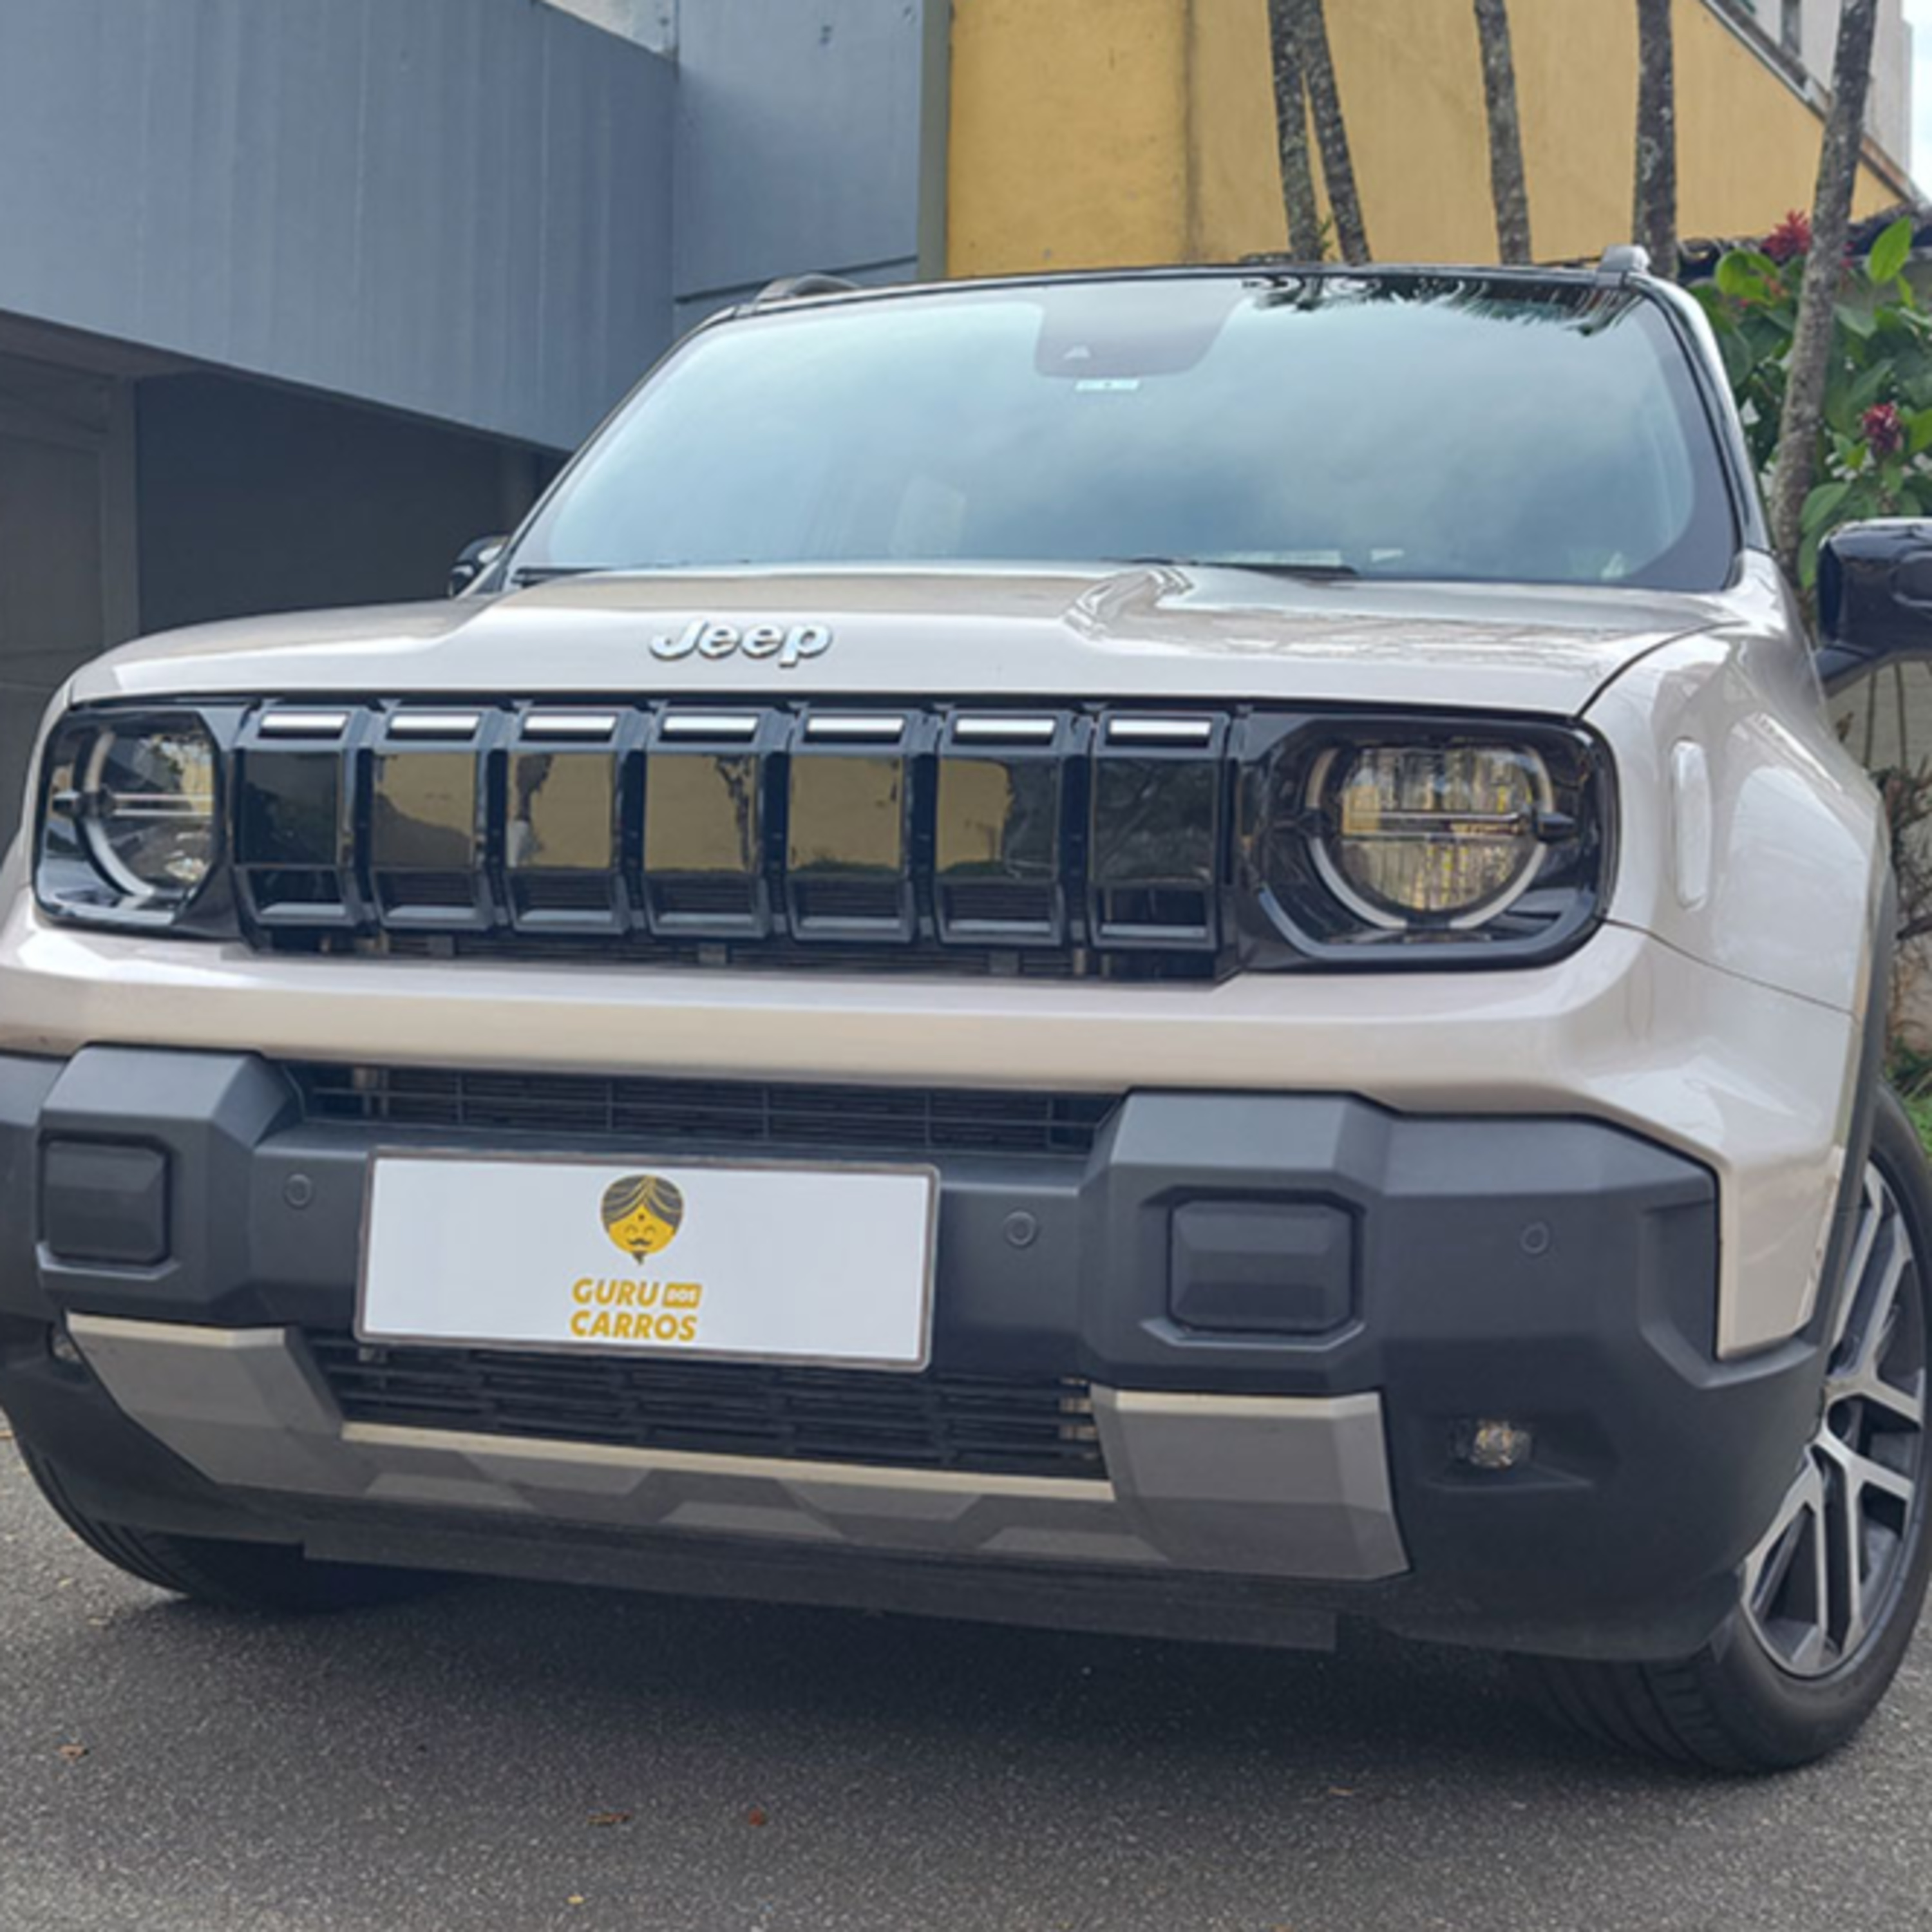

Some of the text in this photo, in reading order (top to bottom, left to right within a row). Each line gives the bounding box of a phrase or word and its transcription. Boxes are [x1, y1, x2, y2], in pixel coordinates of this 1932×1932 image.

[649, 617, 833, 668] Jeep
[572, 1278, 659, 1307] GURU
[571, 1309, 697, 1341] CARROS
